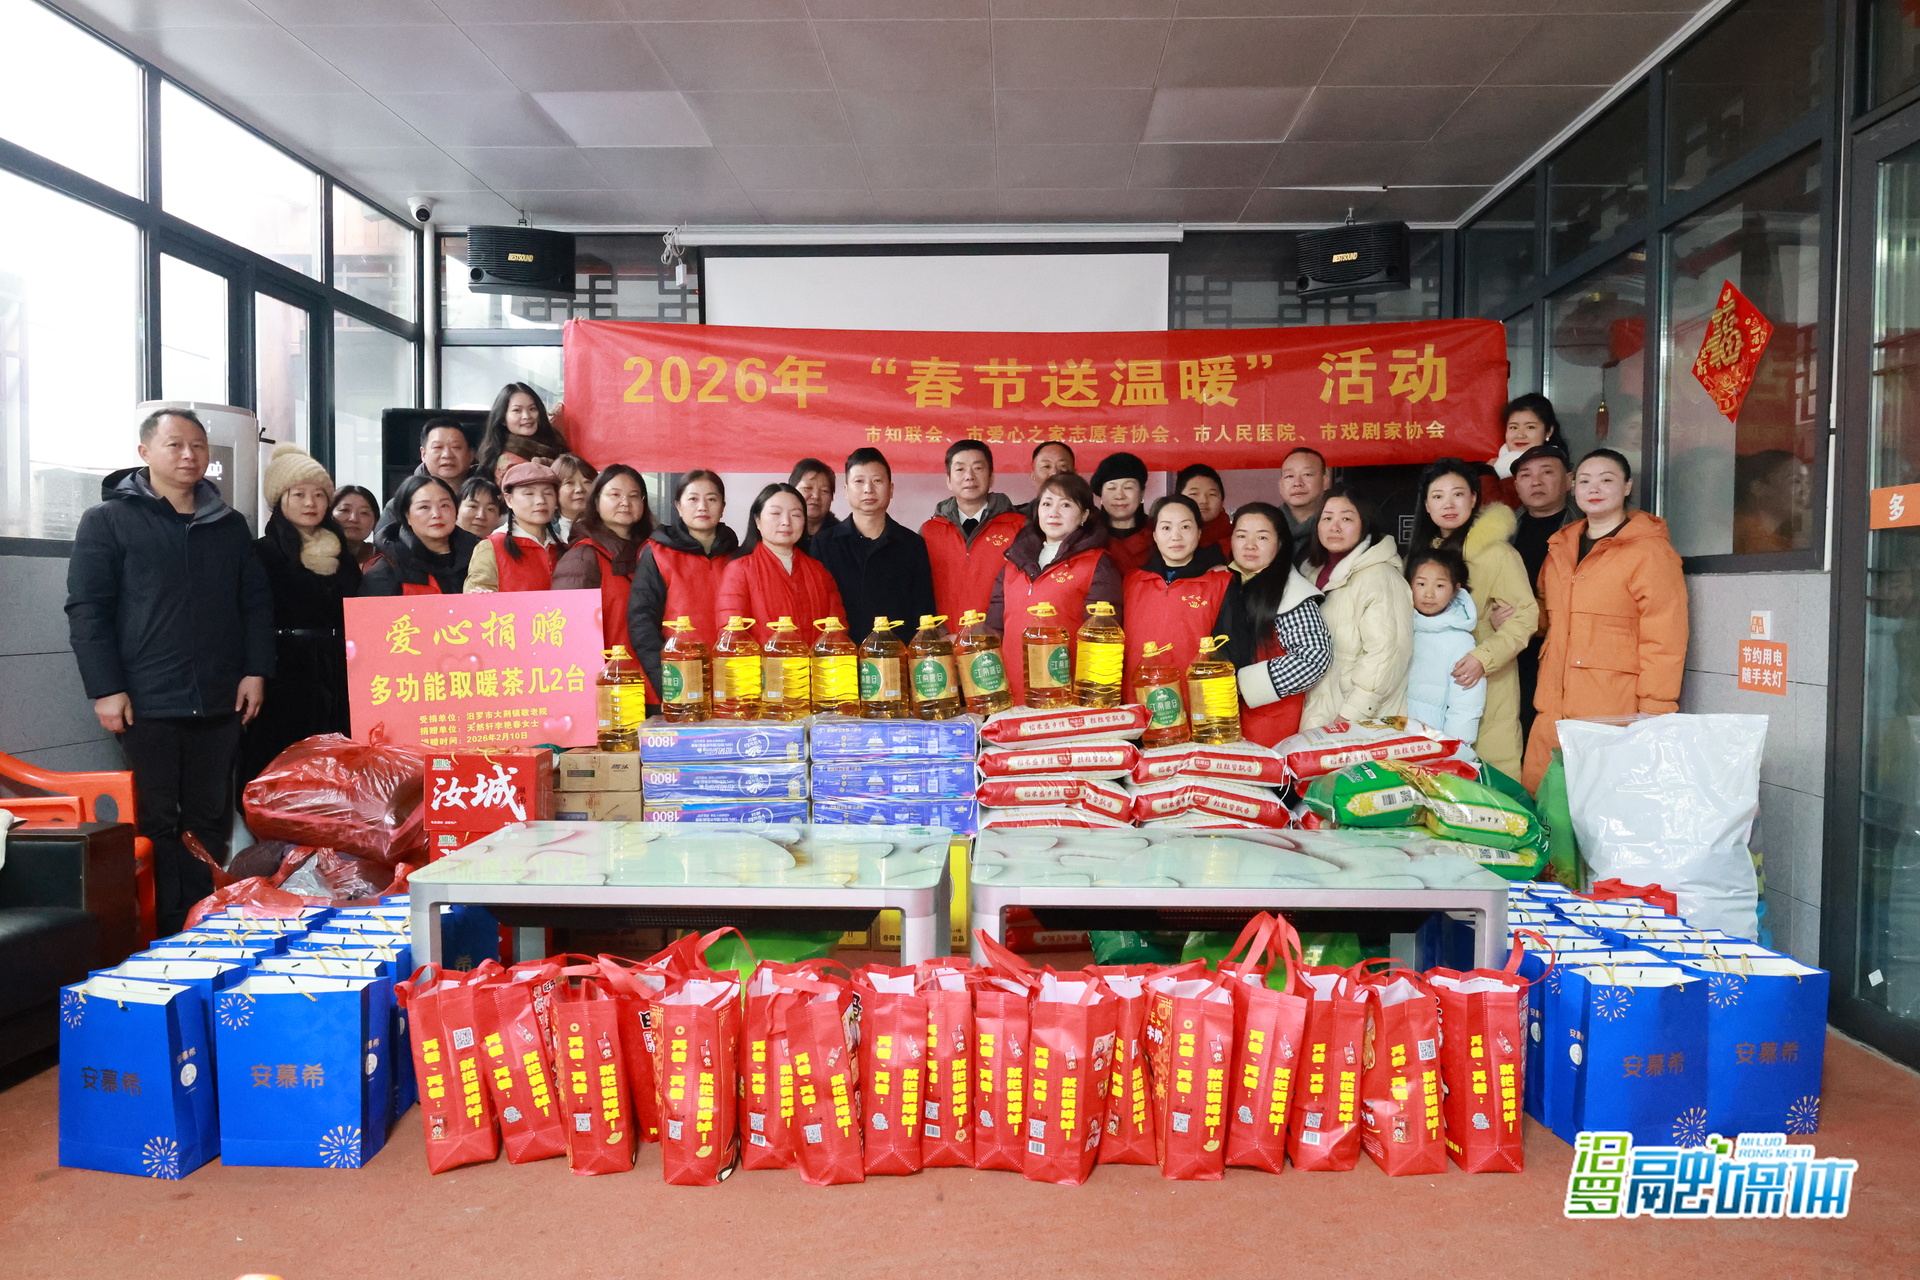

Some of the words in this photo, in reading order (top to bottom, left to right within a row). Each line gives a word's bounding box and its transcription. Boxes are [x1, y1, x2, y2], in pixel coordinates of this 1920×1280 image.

[508, 253, 534, 262] BESTSOUND
[1332, 252, 1358, 262] BESTSOUND
[623, 355, 828, 408] 2026年
[1319, 344, 1448, 404] 活动
[1889, 493, 1905, 521] 多
[385, 608, 568, 655] 爱心捐赠
[1742, 646, 1783, 667] 节约用电
[370, 664, 586, 705] 多功能取暖茶几2台
[1741, 667, 1783, 688] 随手关灯
[466, 731, 528, 743] 2026年2月10日
[648, 736, 676, 747] 1800
[650, 772, 678, 784] 1800
[431, 765, 527, 821] 汝城
[652, 811, 680, 822] 1800
[1622, 1051, 1685, 1078] 安慕希
[1735, 1040, 1798, 1065] 安慕希
[81, 1066, 142, 1096] 安慕希
[250, 1063, 325, 1089] 安慕希
